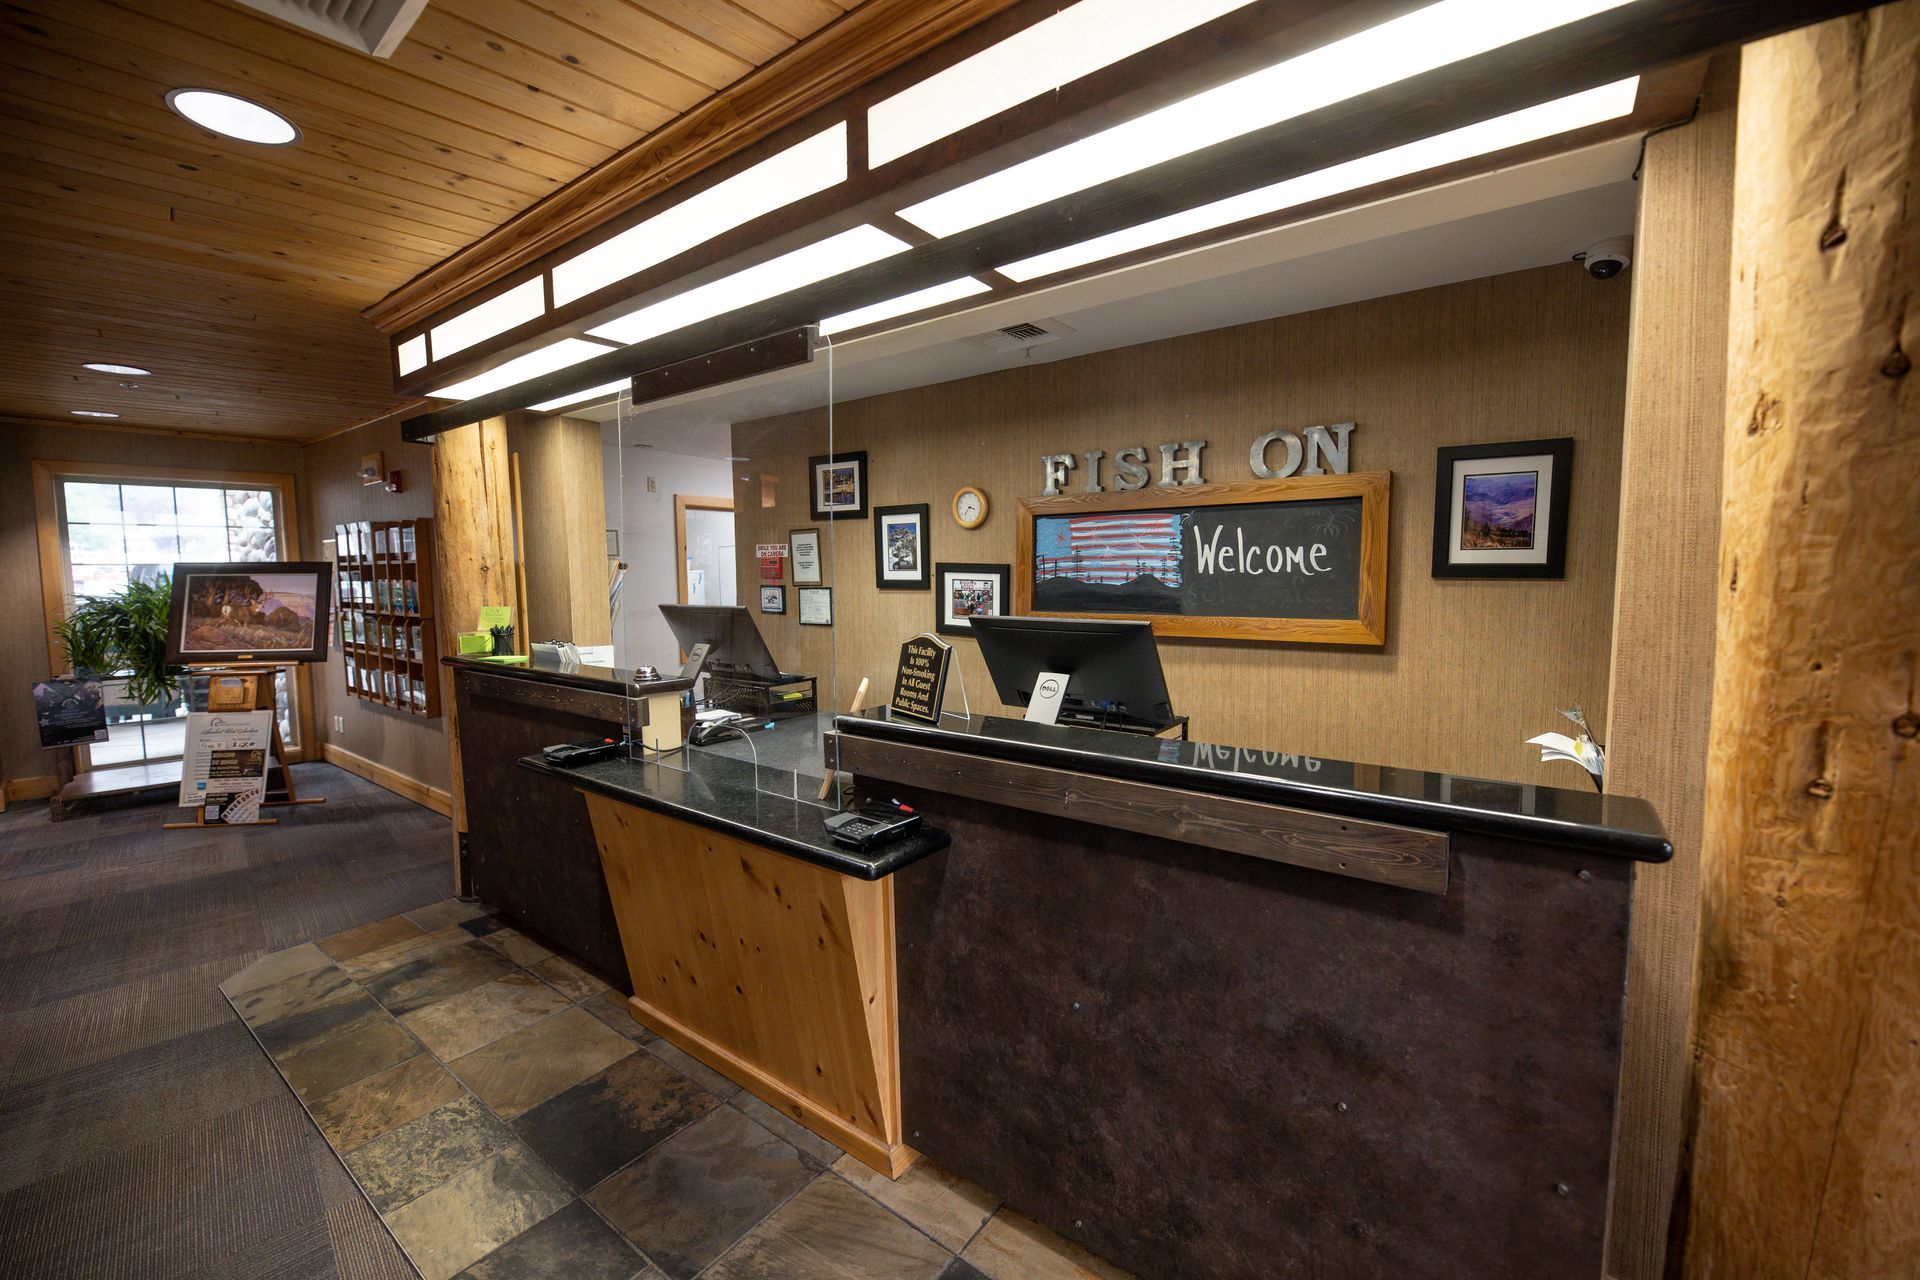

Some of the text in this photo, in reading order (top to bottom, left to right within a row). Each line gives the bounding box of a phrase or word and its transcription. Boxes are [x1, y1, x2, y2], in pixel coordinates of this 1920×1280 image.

[1041, 422, 1357, 496] FISH ON
[1193, 524, 1332, 576] Welcome
[909, 645, 936, 660] This Facility
[910, 656, 930, 667] Is 100%
[902, 666, 935, 683] Non-Smoking
[902, 676, 931, 691] In All Guest
[900, 687, 930, 702] Rooms And
[895, 696, 910, 709] Public
